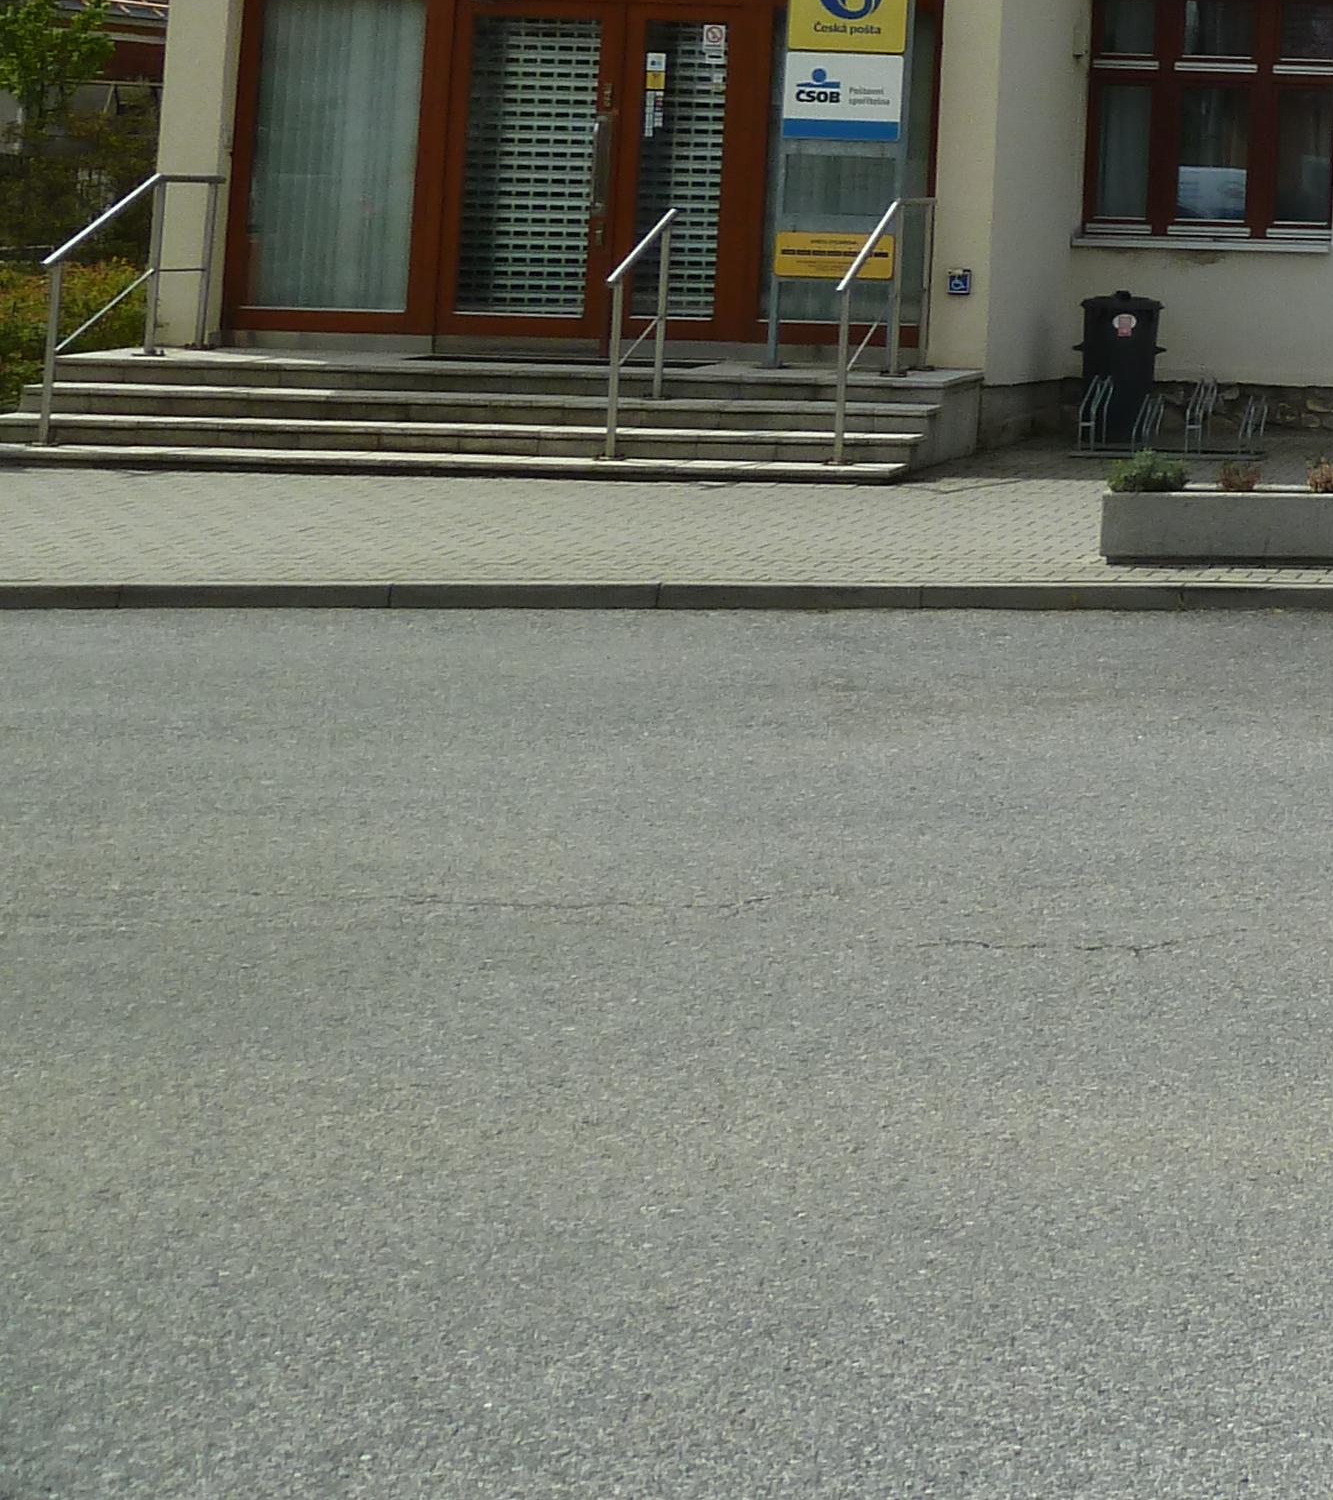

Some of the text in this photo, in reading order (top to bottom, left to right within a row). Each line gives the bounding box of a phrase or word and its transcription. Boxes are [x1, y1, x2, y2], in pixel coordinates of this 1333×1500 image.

[814, 21, 881, 35] Česká pošta
[796, 89, 841, 103] ČSOB
